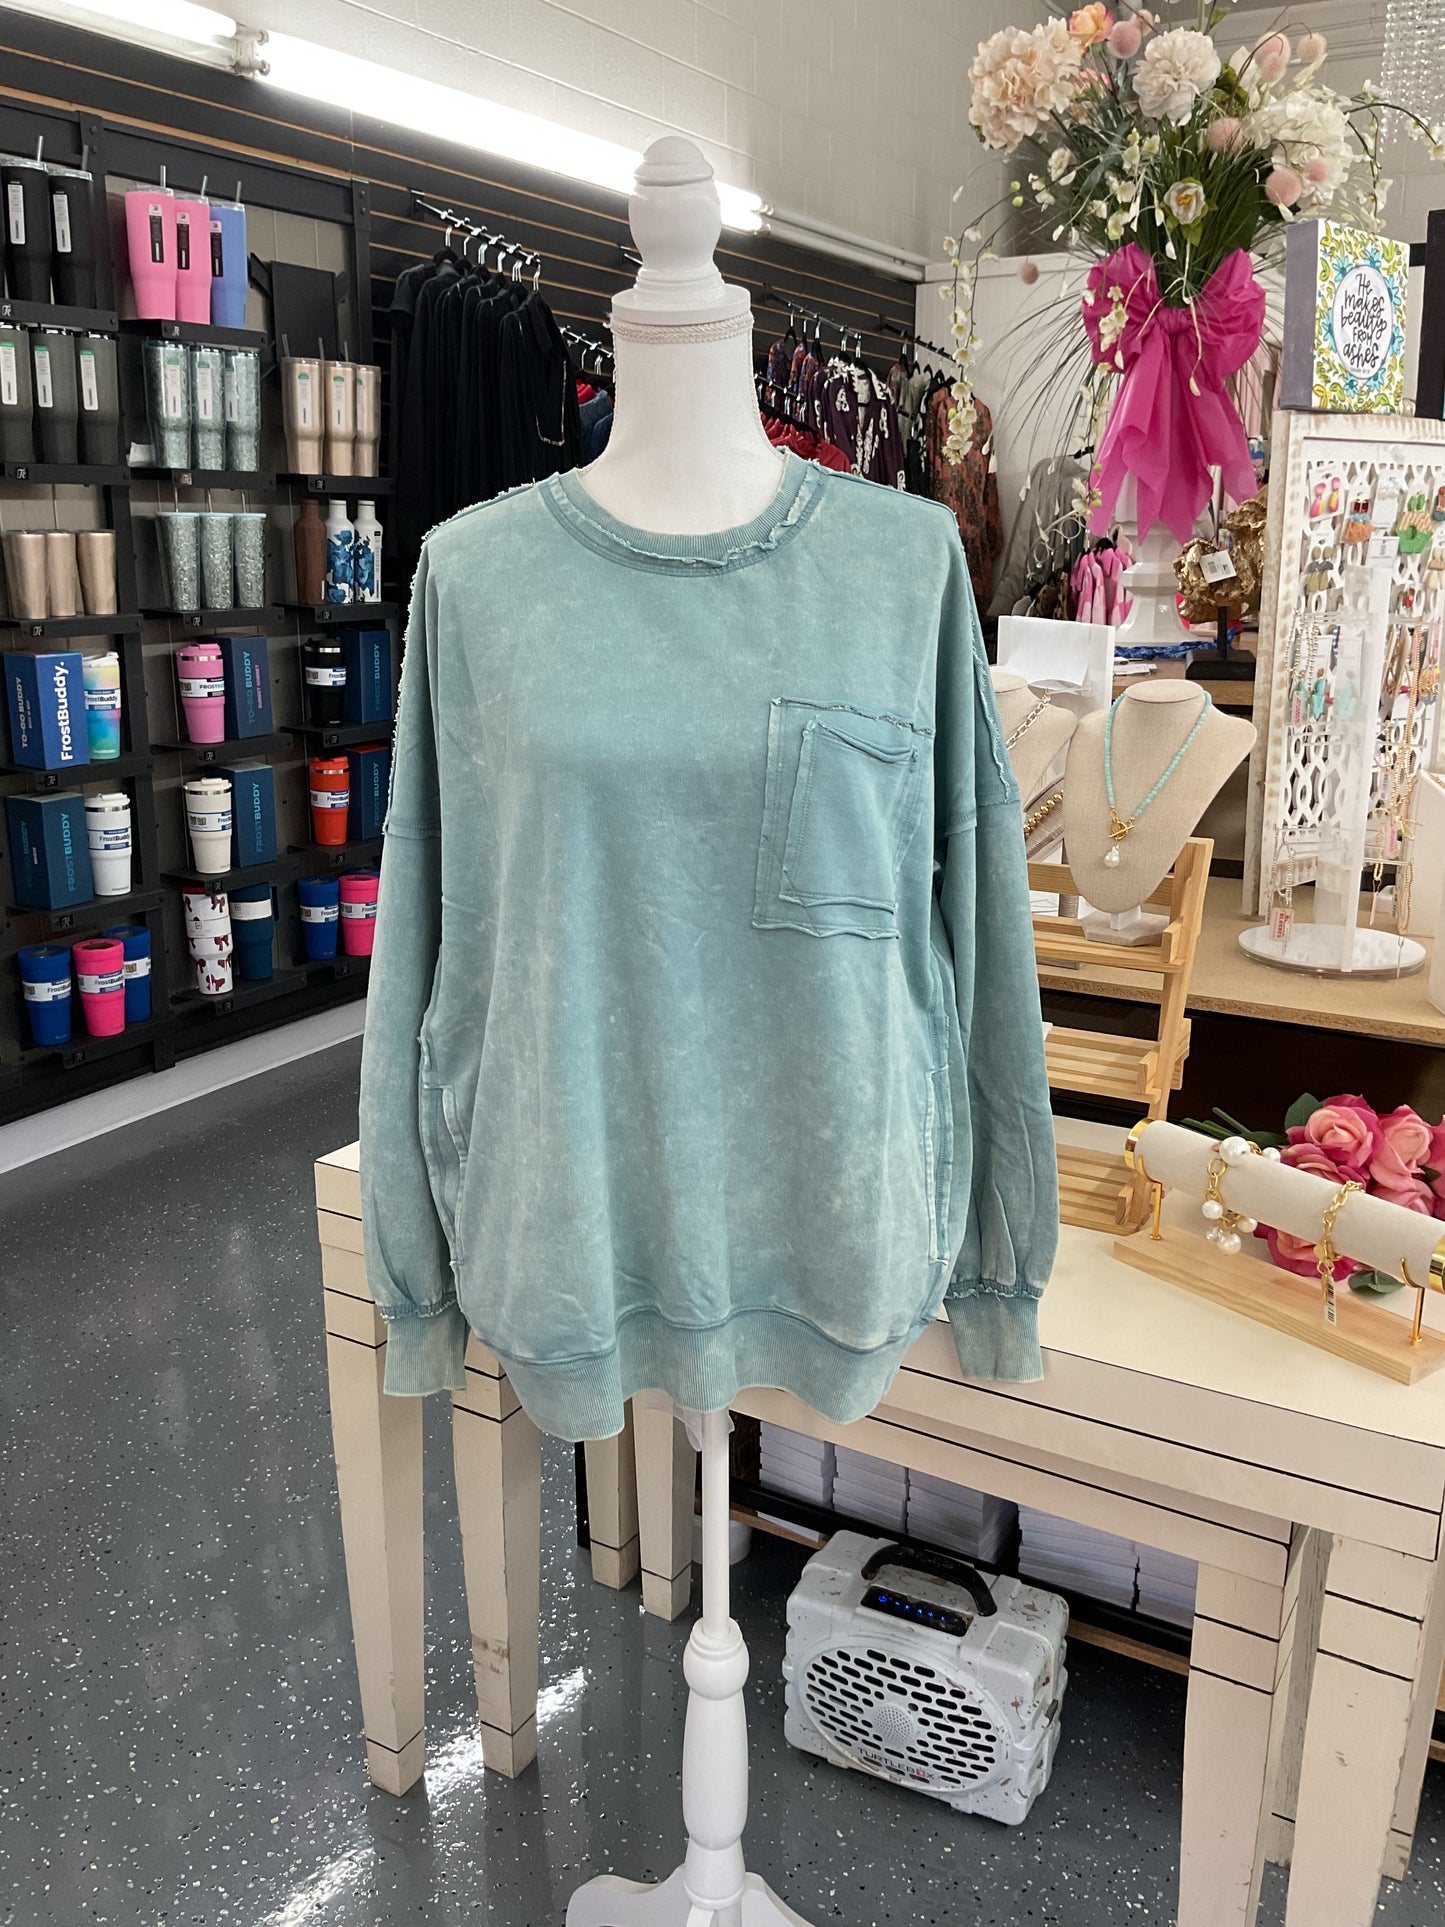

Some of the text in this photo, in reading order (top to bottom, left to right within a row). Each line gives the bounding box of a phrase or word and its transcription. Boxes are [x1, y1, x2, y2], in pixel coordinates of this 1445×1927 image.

[1355, 273, 1372, 296] He
[1344, 290, 1385, 318] makes
[1341, 305, 1388, 340] beauty
[1352, 326, 1373, 346] FROM
[1343, 343, 1380, 368] ashes
[242, 651, 253, 688] BUDDY
[15, 676, 29, 749] TO-GO BUDDY
[53, 661, 73, 761] FrostBuddy.
[252, 782, 264, 853] FROSTBUDDY
[21, 820, 30, 855] BUDDY
[61, 812, 76, 892] FROSTBUDDY
[857, 1746, 934, 1779] TURTLEBOX
